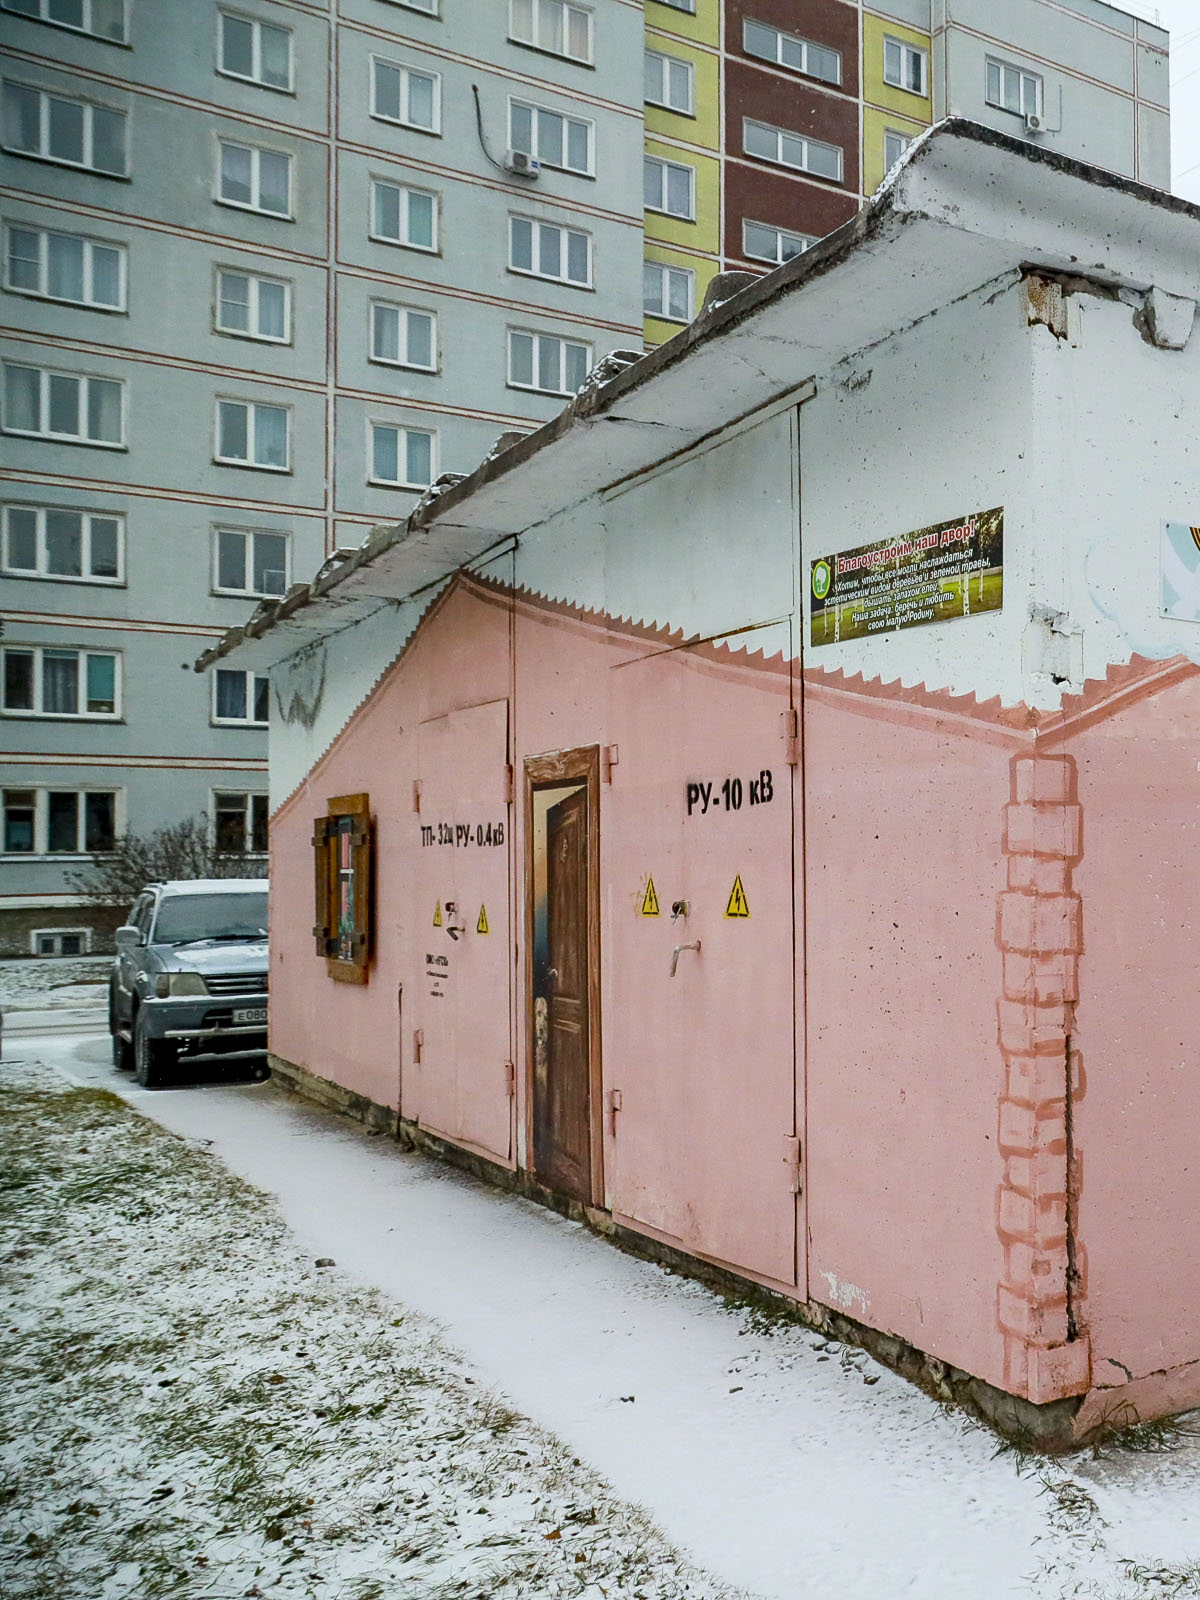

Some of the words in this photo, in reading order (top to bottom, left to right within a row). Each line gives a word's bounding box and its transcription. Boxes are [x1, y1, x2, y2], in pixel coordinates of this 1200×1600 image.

[838, 541, 913, 573] Благоустроим
[915, 533, 938, 551] наш
[941, 519, 975, 547] двор!
[824, 588, 869, 606] эстетическим
[870, 582, 890, 594] видом
[892, 574, 922, 589] деревьев
[930, 563, 960, 579] зеленой
[962, 557, 991, 573] травы,
[837, 579, 859, 592] Хотим,
[862, 572, 884, 584] чтобы
[885, 569, 896, 579] все
[897, 563, 918, 576] могли
[920, 548, 973, 570] наслаждаться
[851, 612, 869, 622] Наша
[870, 606, 894, 618] задача:
[894, 601, 917, 613] беречь
[924, 591, 955, 603] любить
[864, 595, 892, 608] дышать
[893, 587, 920, 600] запахом
[868, 621, 884, 631] свою
[885, 613, 907, 626] малую
[908, 608, 935, 621] Родину.
[749, 769, 774, 806] кВ
